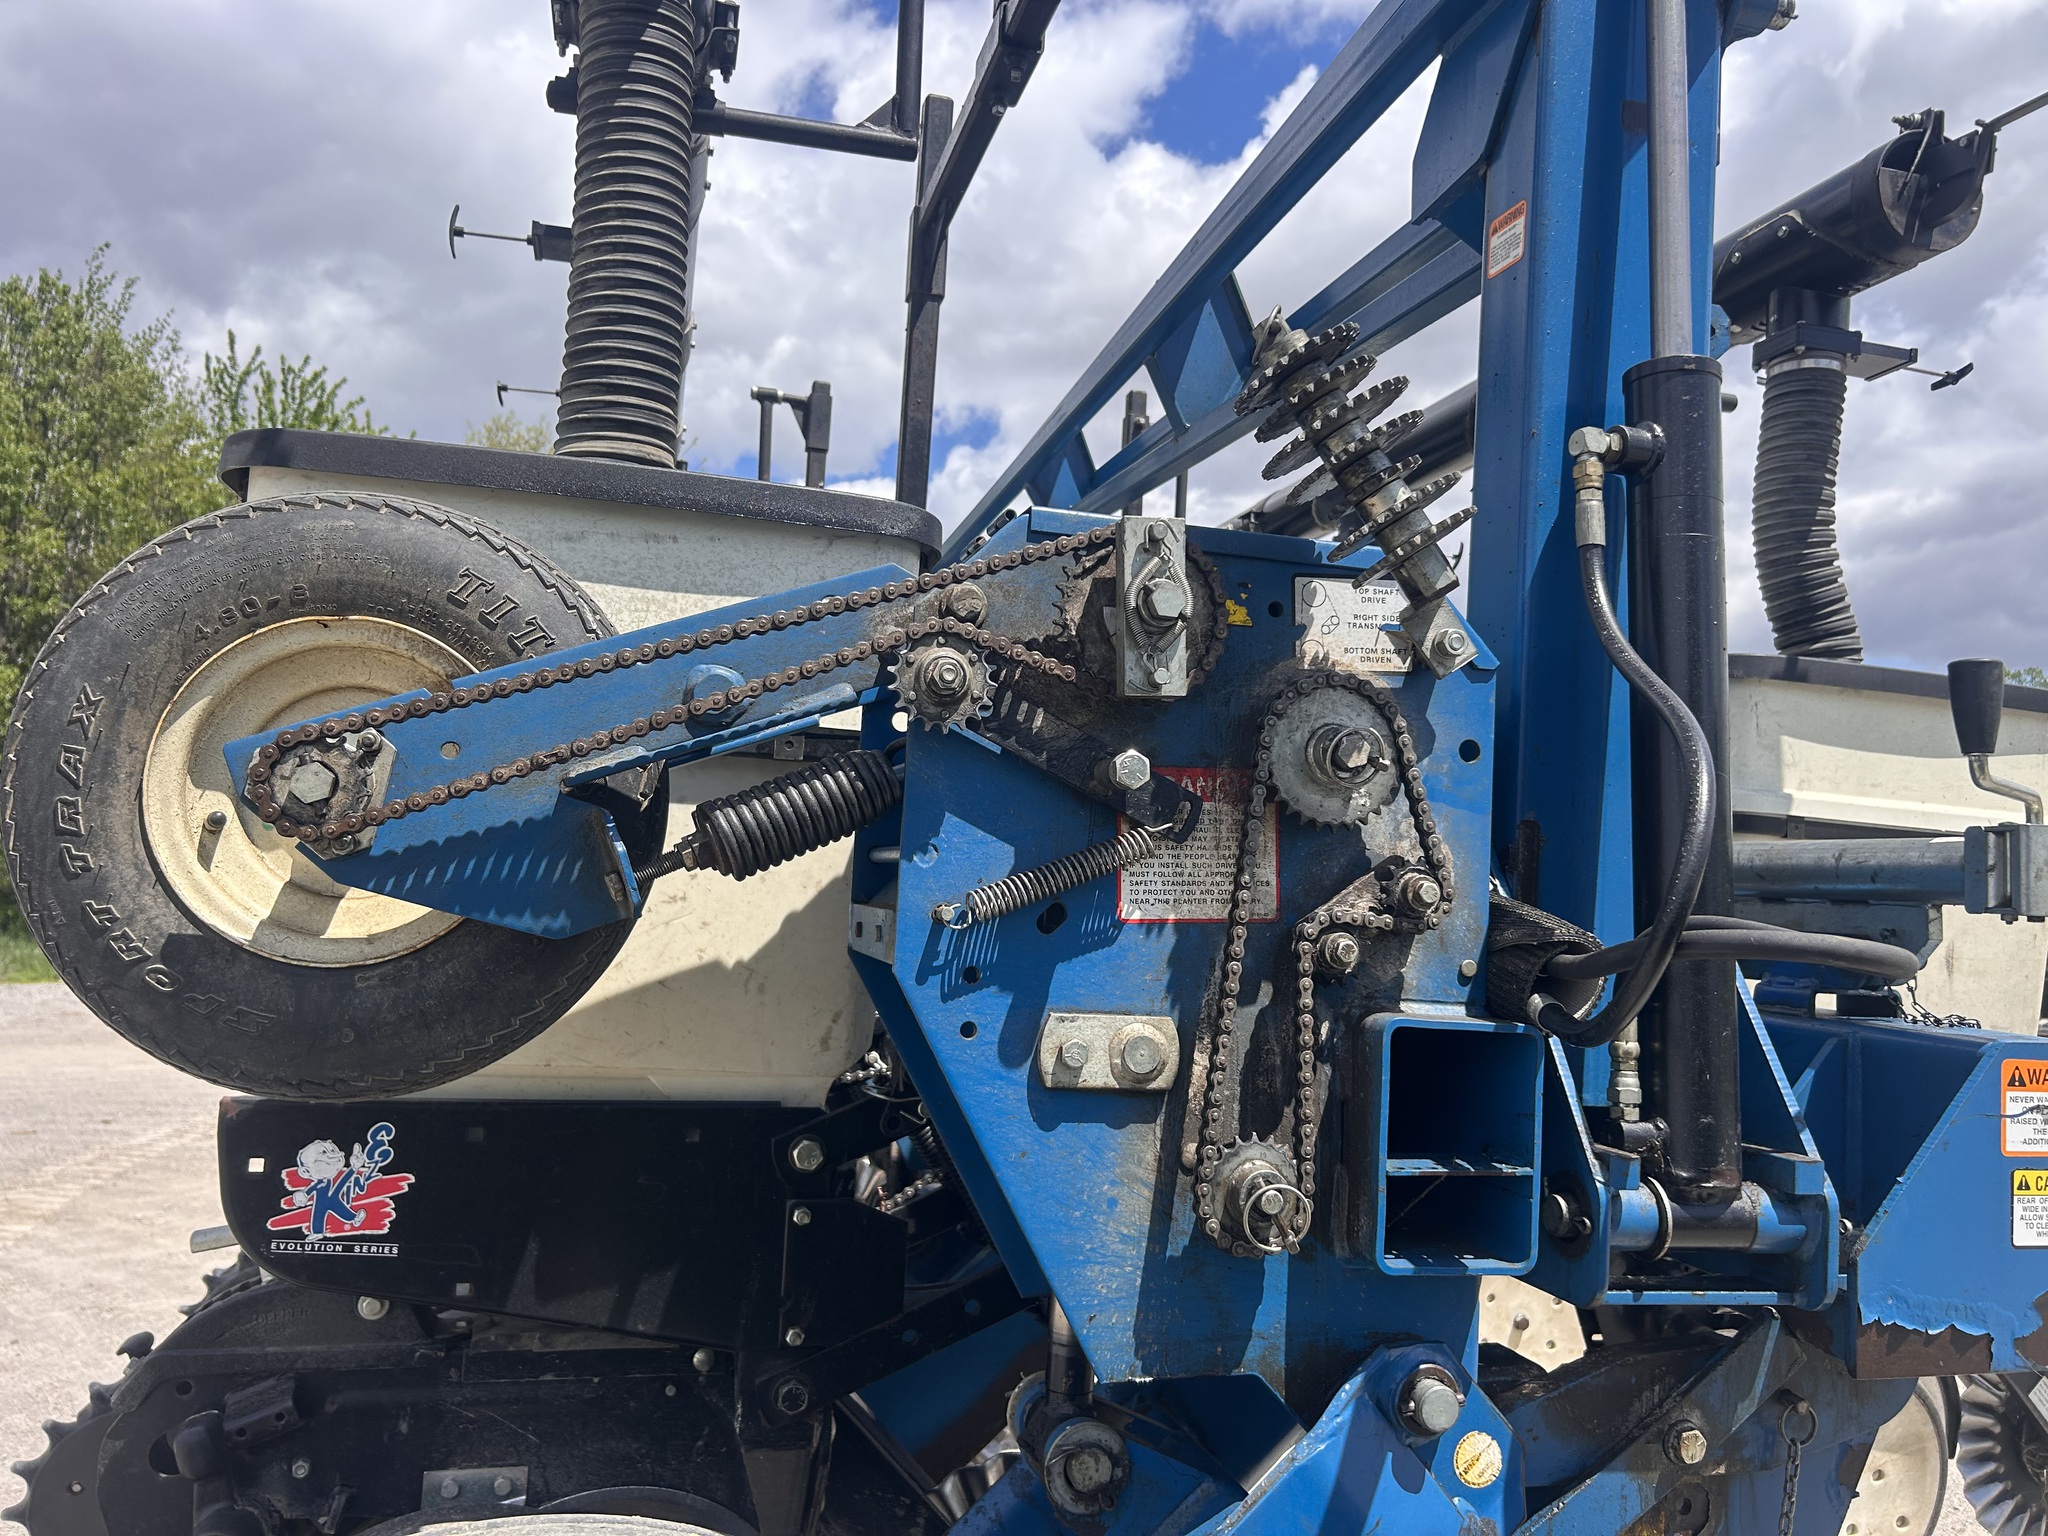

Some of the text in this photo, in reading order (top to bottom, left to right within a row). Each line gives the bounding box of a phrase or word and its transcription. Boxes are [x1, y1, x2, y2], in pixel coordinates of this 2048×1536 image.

[106, 579, 154, 623] DANGER
[1372, 588, 1400, 596] SHAFT
[194, 583, 309, 643] 4.80-8
[447, 566, 556, 659] TIT
[1344, 647, 1408, 656] BOTTOM SHAFT
[1360, 656, 1392, 664] DRIVEN
[53, 682, 104, 881] TRAX
[271, 1242, 399, 1254] EVOLUTION SERIES
